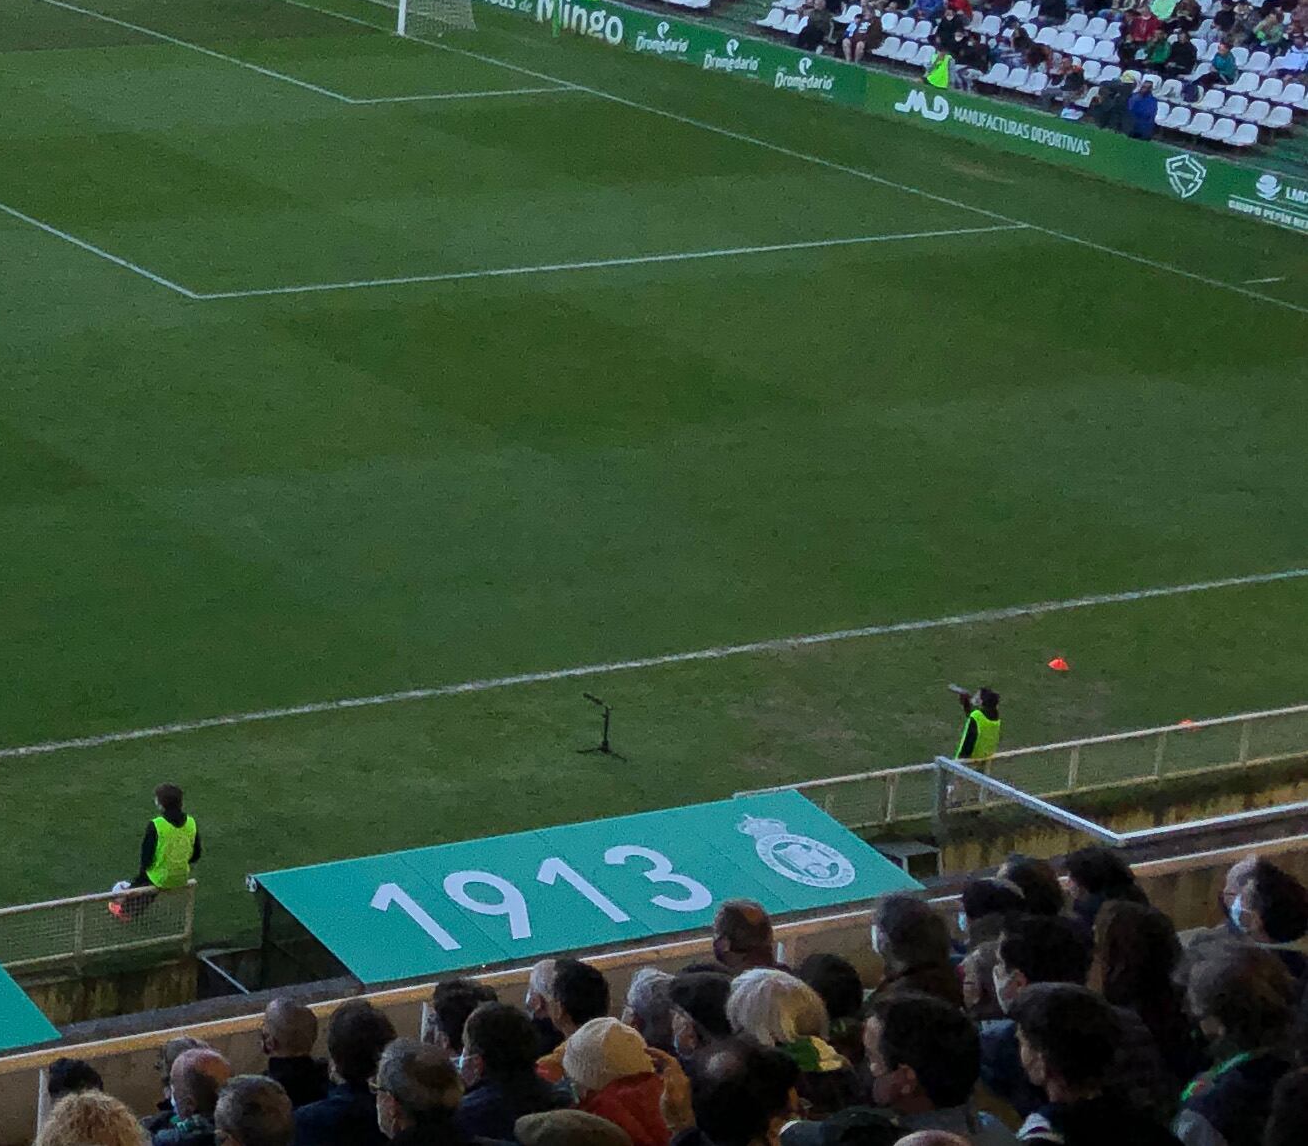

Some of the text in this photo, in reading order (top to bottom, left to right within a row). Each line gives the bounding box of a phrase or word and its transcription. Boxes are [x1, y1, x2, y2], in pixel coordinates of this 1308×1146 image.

[636, 34, 689, 54] Dromedario
[703, 53, 759, 72] Dromedario
[774, 71, 833, 92] Dromedario
[953, 105, 1091, 156] MANUFACTURAS DEPORTIVAS
[370, 844, 713, 951] 1913
